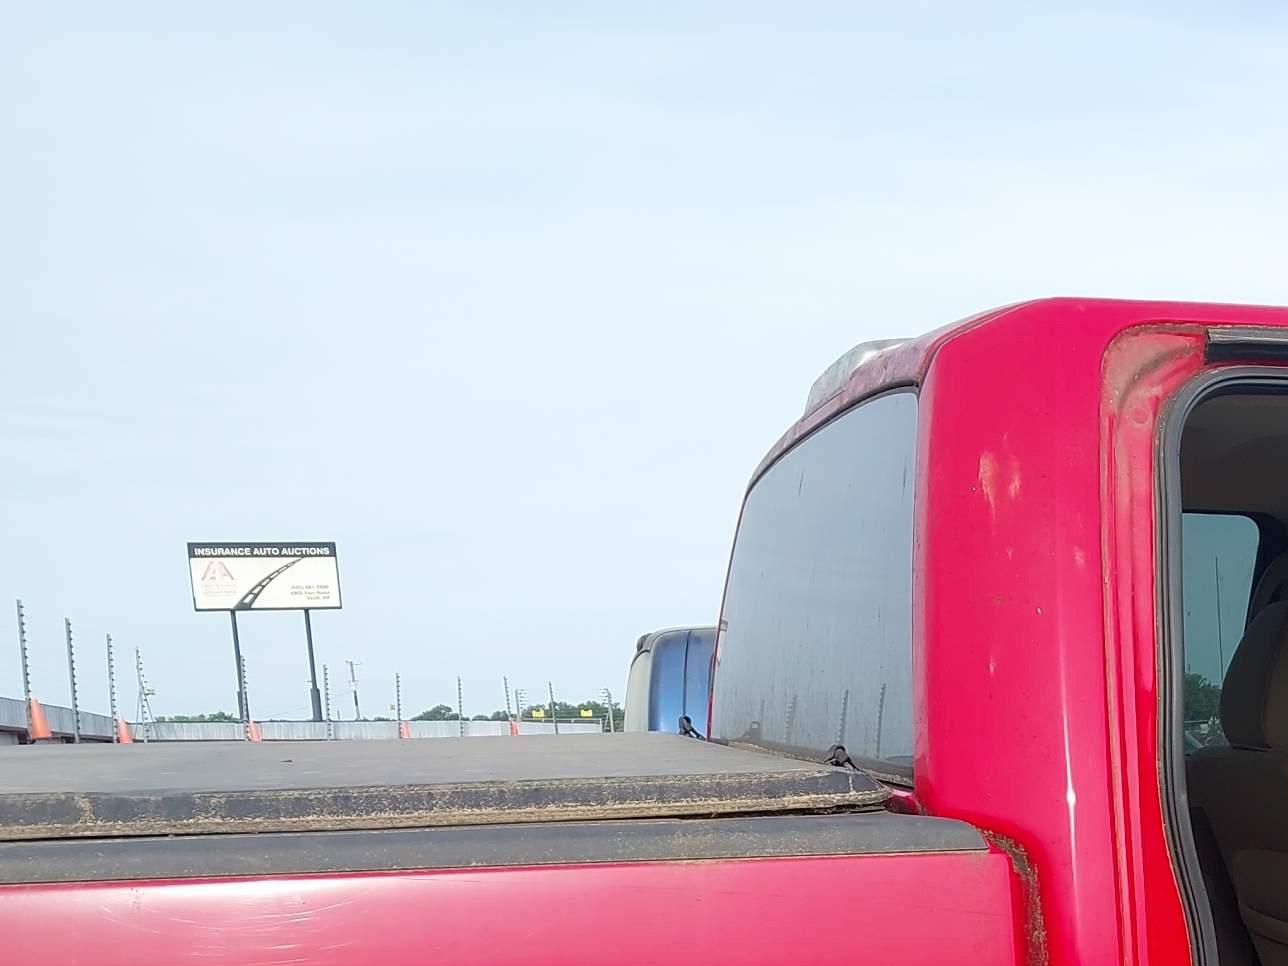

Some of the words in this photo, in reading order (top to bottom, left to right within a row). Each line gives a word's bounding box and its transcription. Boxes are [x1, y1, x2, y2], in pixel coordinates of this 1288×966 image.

[193, 547, 251, 556] INSURANCE
[252, 547, 280, 556] AUTO
[281, 547, 330, 556] AUCTIONS
